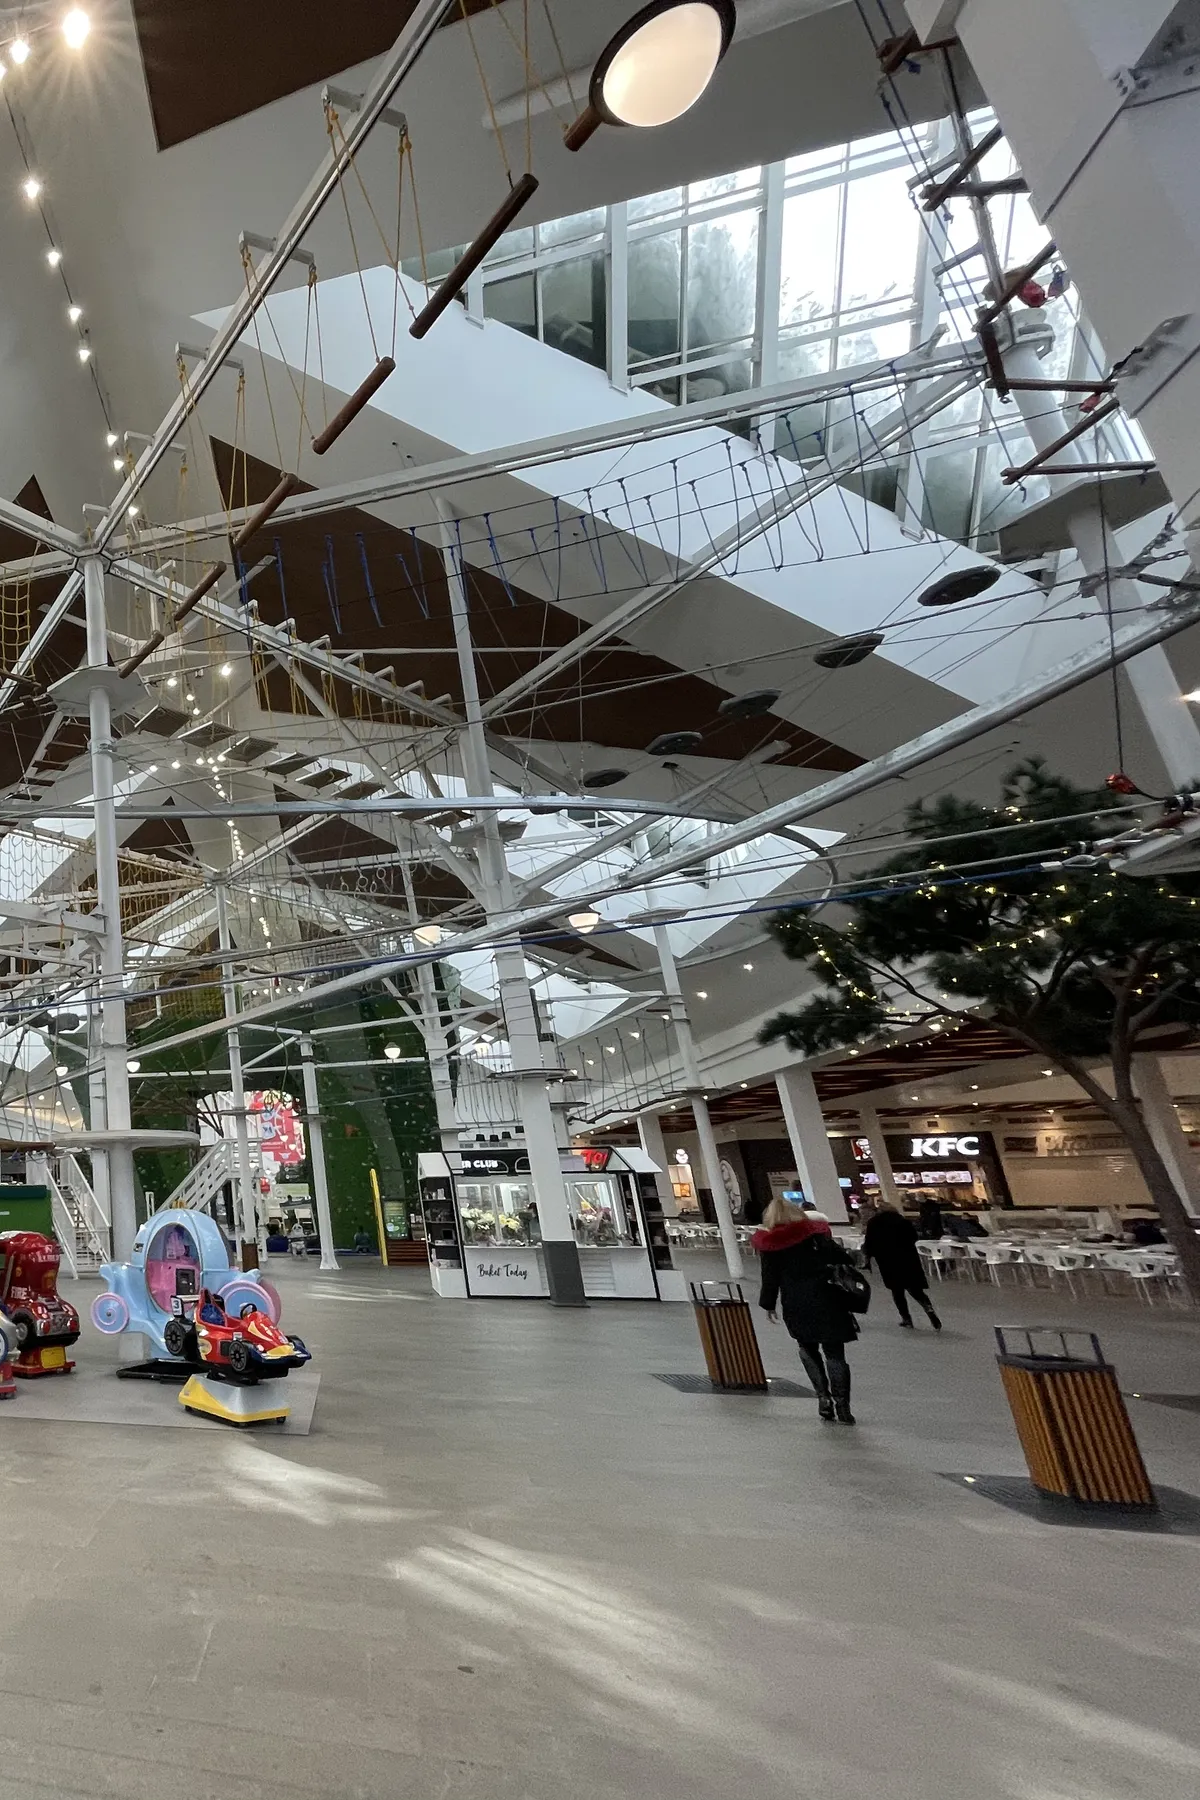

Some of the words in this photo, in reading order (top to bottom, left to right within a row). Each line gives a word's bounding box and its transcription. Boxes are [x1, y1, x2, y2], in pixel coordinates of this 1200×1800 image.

[910, 1136, 980, 1157] KFC
[473, 1159, 499, 1169] CLUB
[503, 1263, 528, 1281] Today
[11, 1286, 28, 1300] FIRE
[172, 1300, 180, 1310] 3
